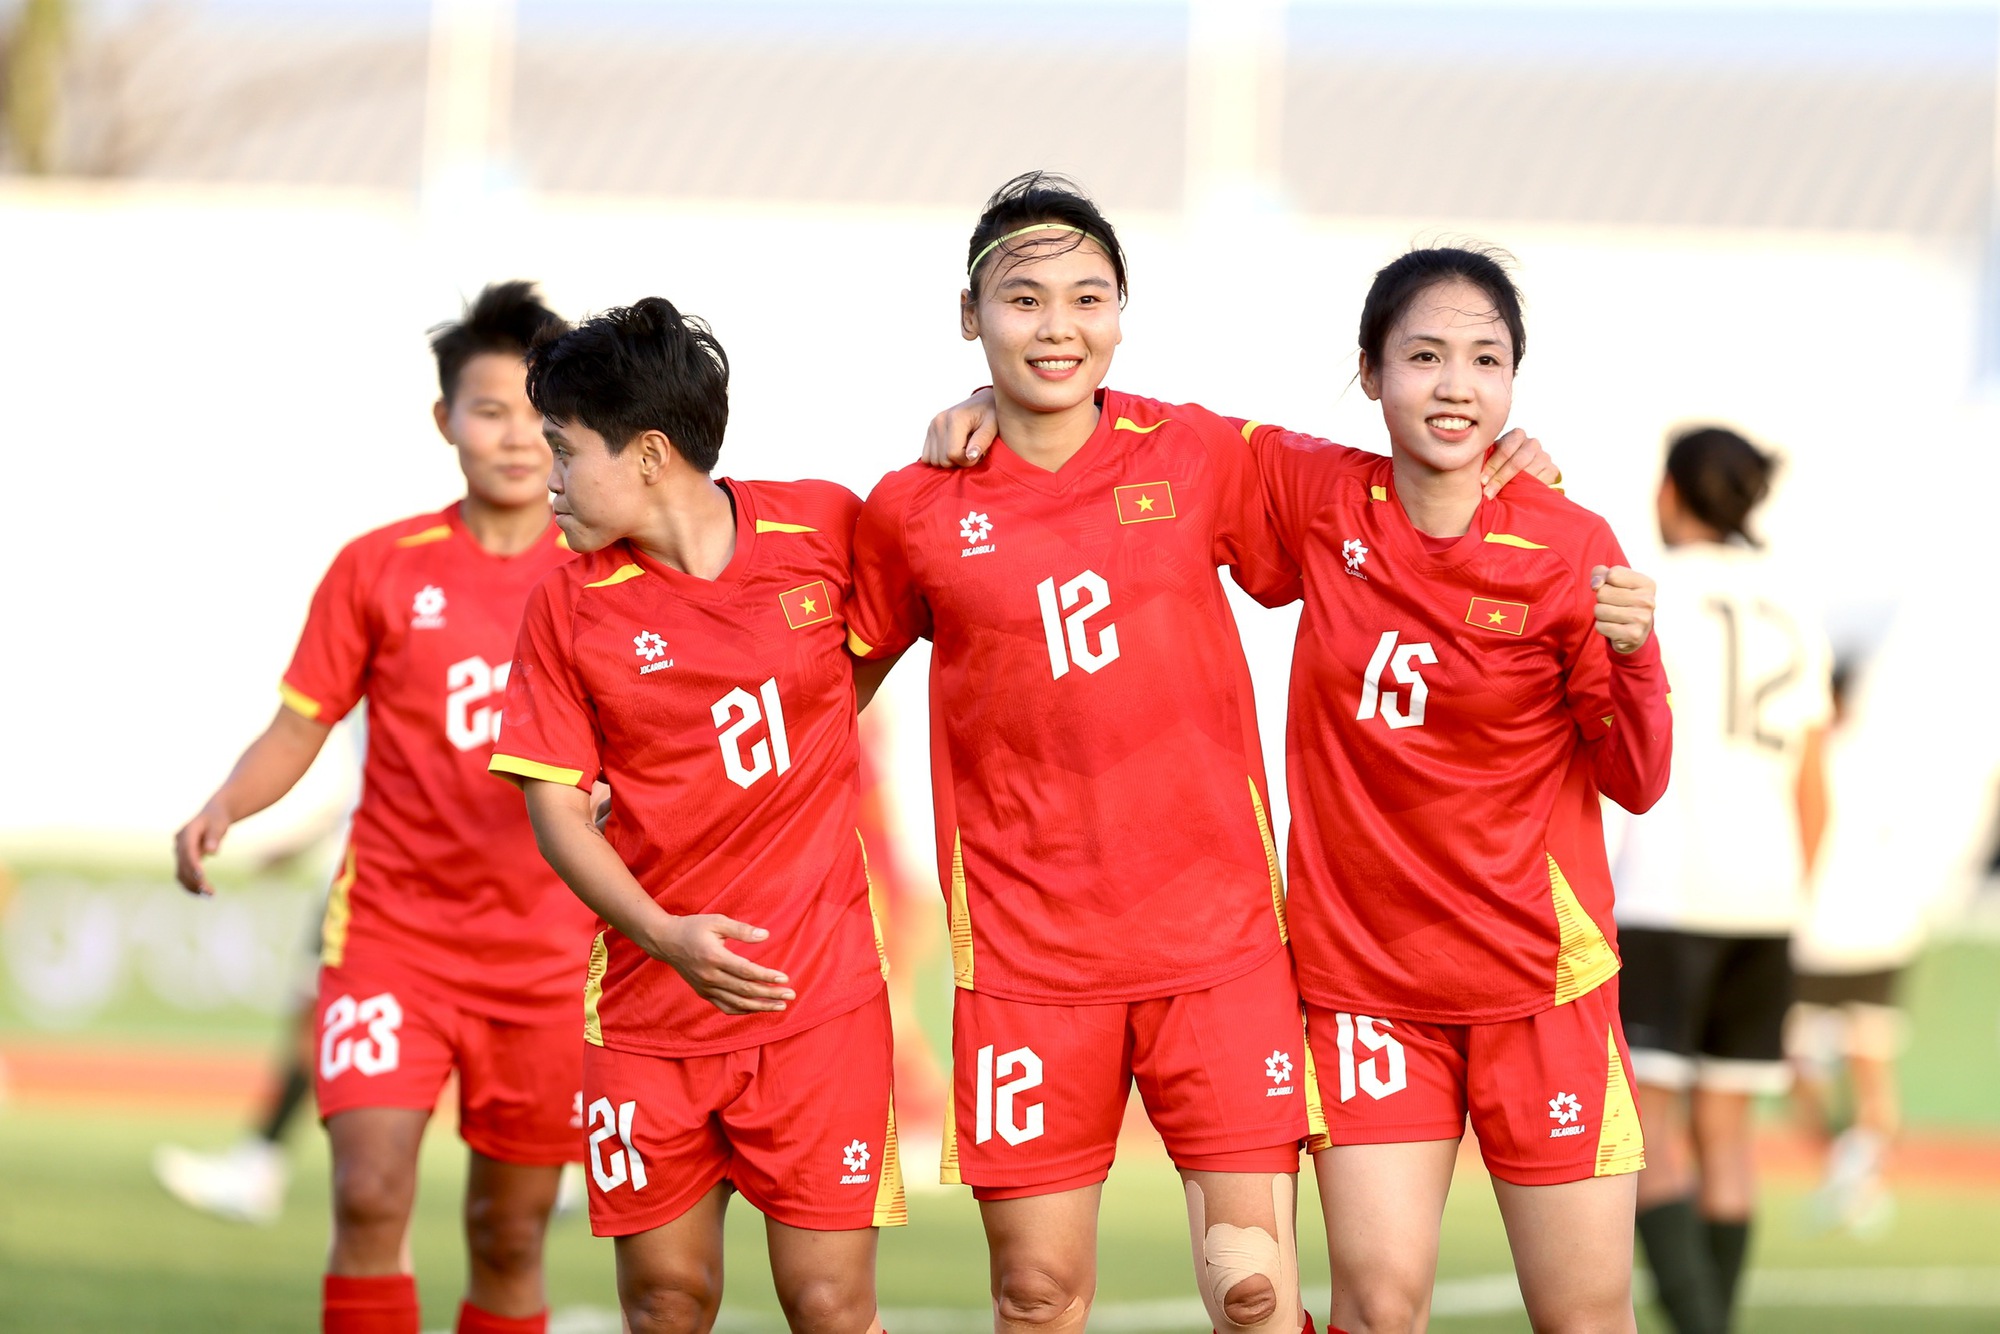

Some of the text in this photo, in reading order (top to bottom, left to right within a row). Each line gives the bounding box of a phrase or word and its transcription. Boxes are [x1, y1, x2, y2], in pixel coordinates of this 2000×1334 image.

[961, 543, 996, 558] JOGARBOLA
[639, 657, 674, 675] JOGARBOLA
[1037, 569, 1121, 681] 12
[1356, 630, 1439, 730] 15
[1707, 597, 1802, 754] 12
[710, 676, 792, 790] 21
[320, 991, 404, 1082] 23
[1335, 1012, 1408, 1104] 15
[588, 1096, 648, 1194] 21
[975, 1044, 1045, 1147] 12
